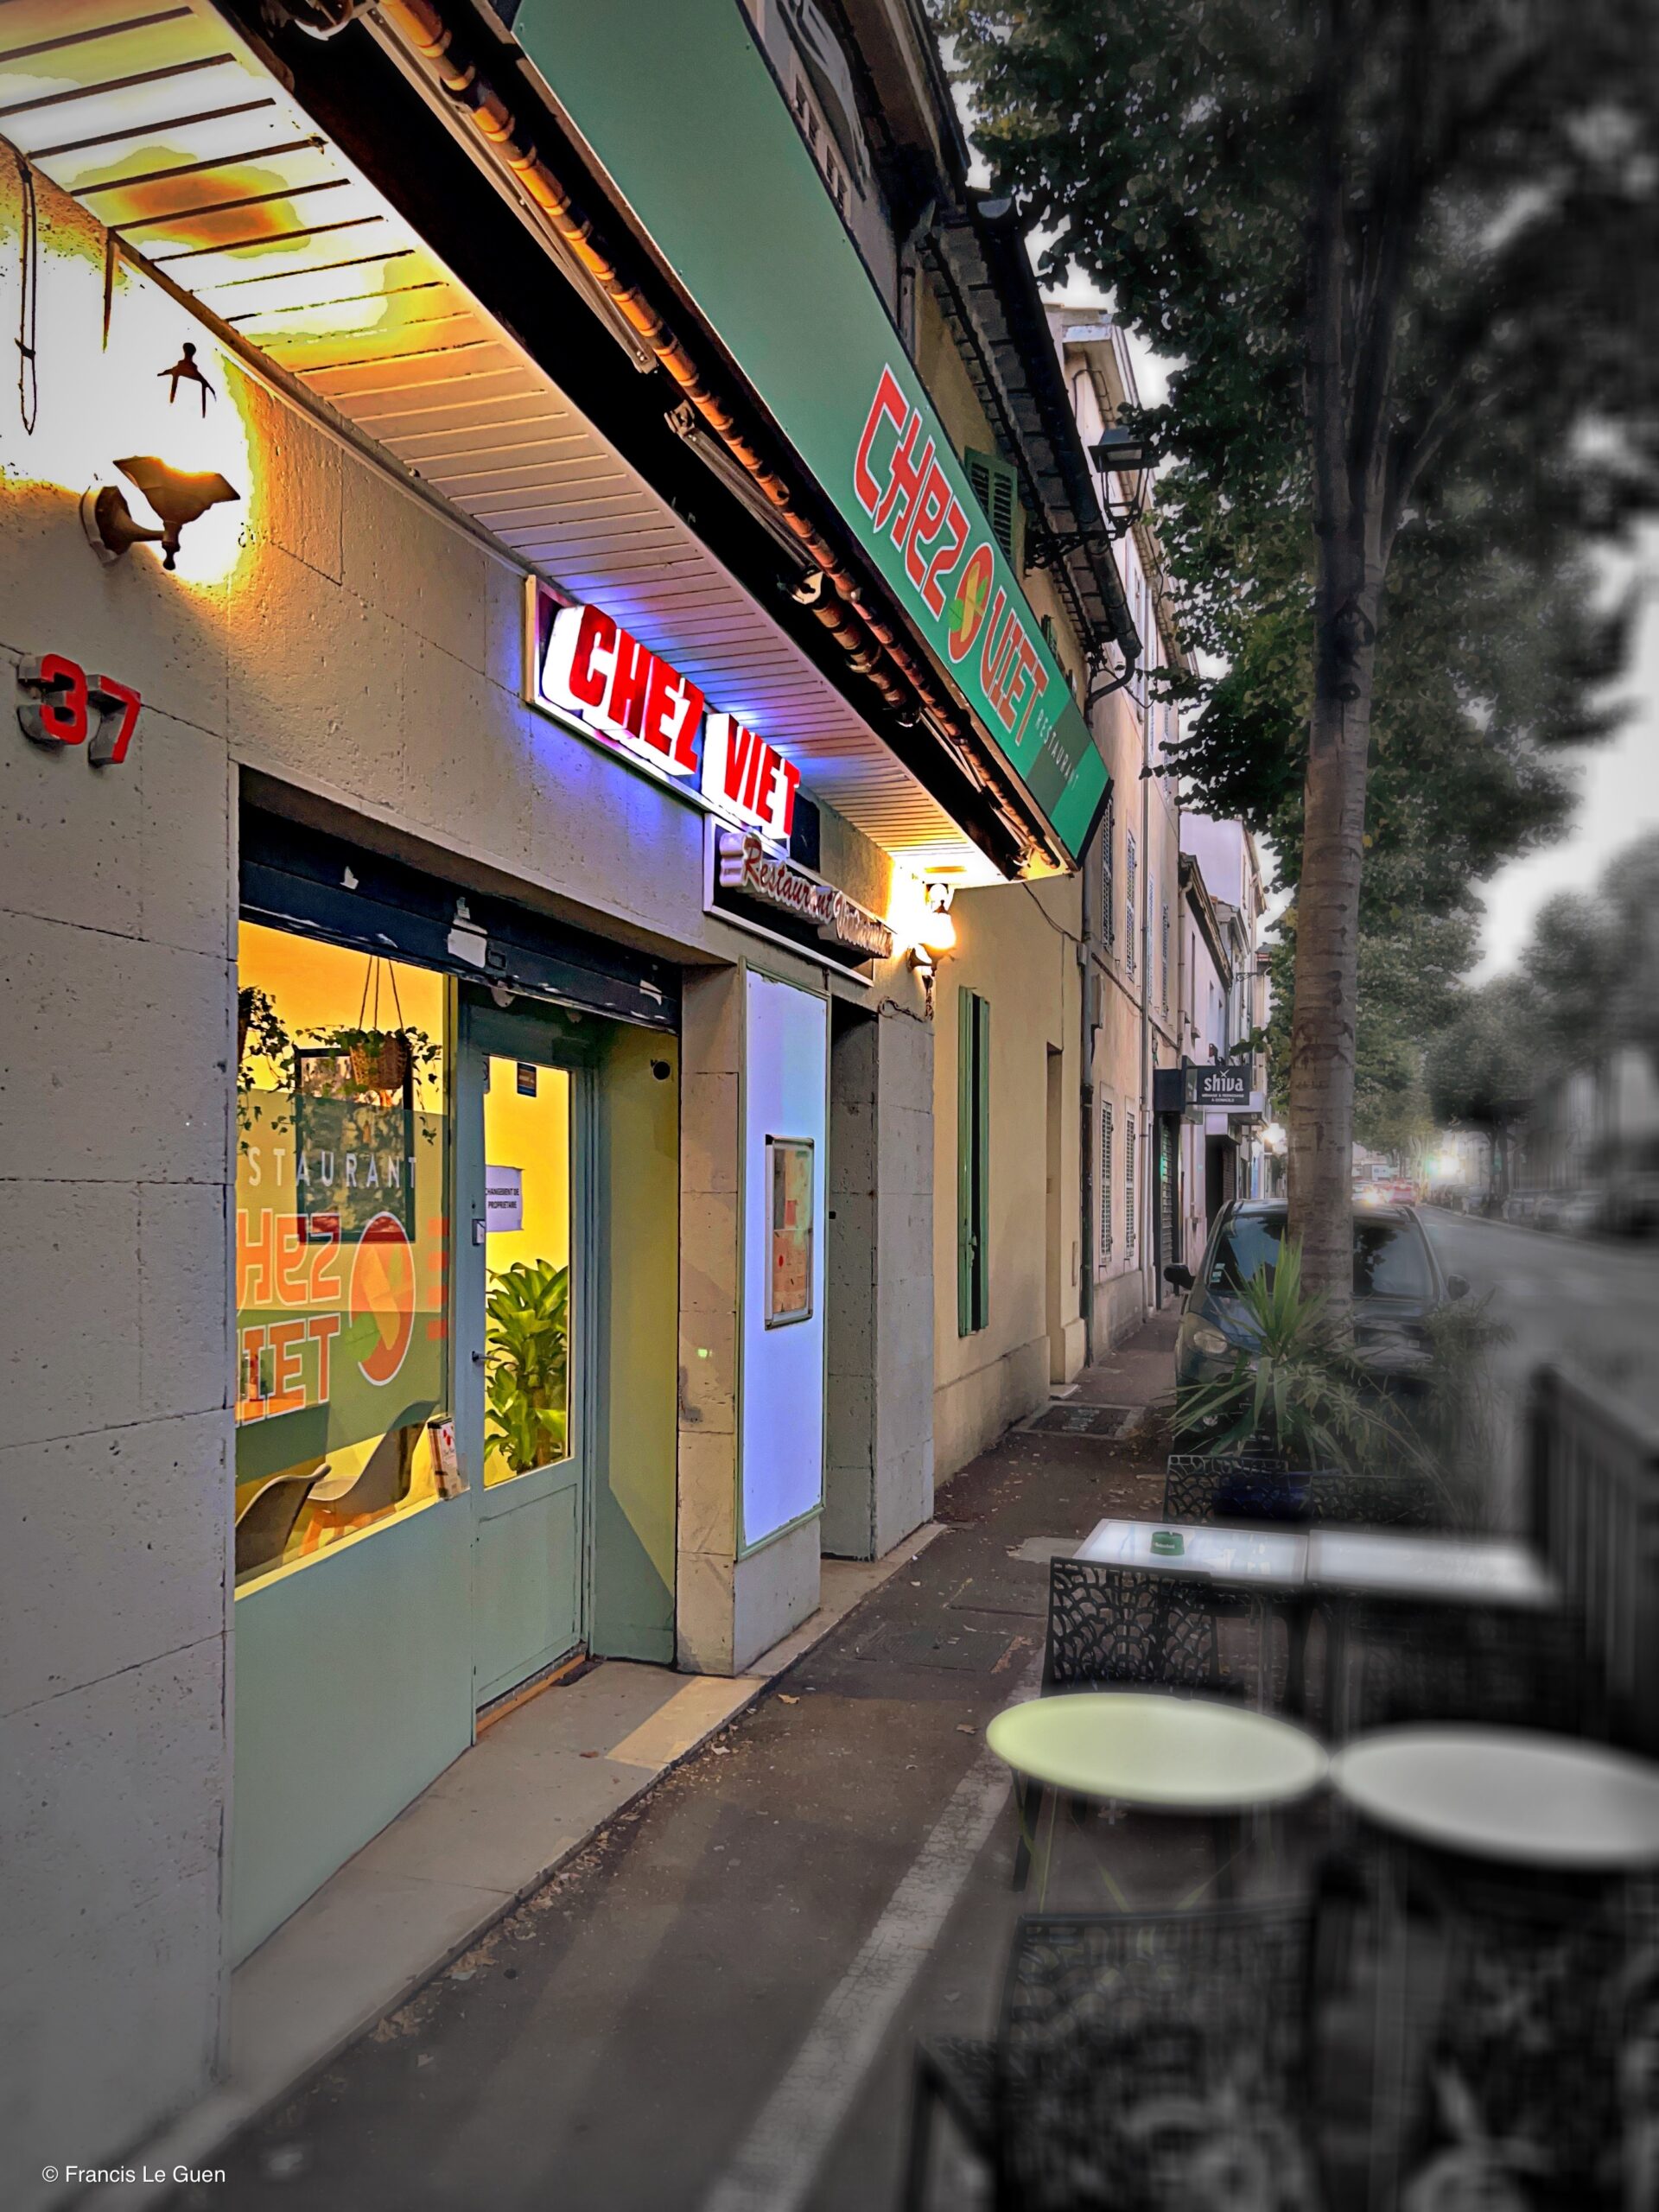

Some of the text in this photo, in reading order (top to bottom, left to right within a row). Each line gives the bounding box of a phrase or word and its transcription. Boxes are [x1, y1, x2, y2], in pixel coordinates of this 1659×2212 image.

[39, 653, 142, 764] 37
[569, 604, 800, 838] CHEZ VIET
[979, 586, 1050, 747] VIET
[1035, 709, 1078, 790] RESTAURANT
[1204, 1071, 1244, 1092] shiva
[248, 1146, 416, 1188] STAURANT
[235, 1313, 341, 1428] IET
